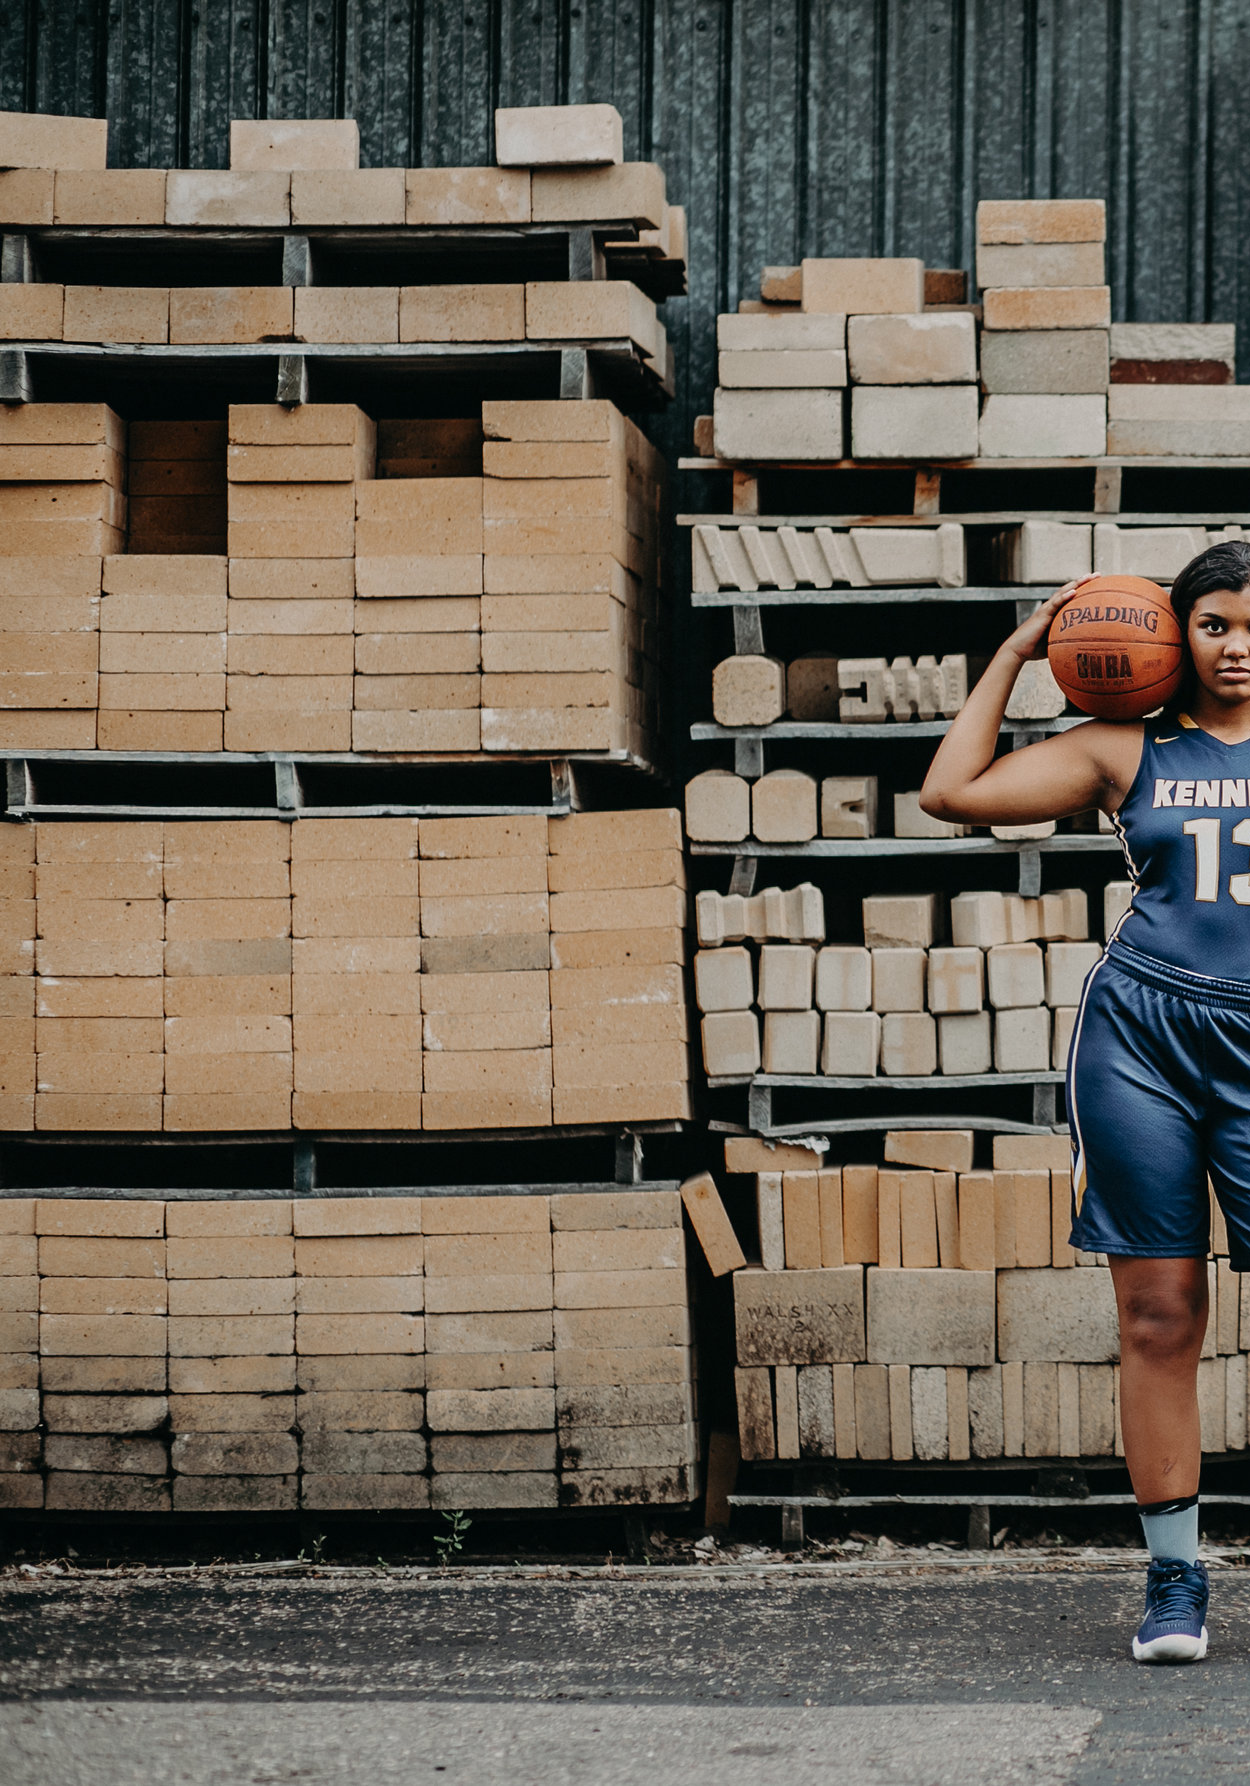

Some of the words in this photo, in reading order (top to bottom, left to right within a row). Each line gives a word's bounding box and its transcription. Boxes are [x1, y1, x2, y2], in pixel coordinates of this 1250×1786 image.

[1059, 606, 1159, 634] SPALDING
[1089, 653, 1133, 679] NBA
[747, 1304, 815, 1320] WALSH
